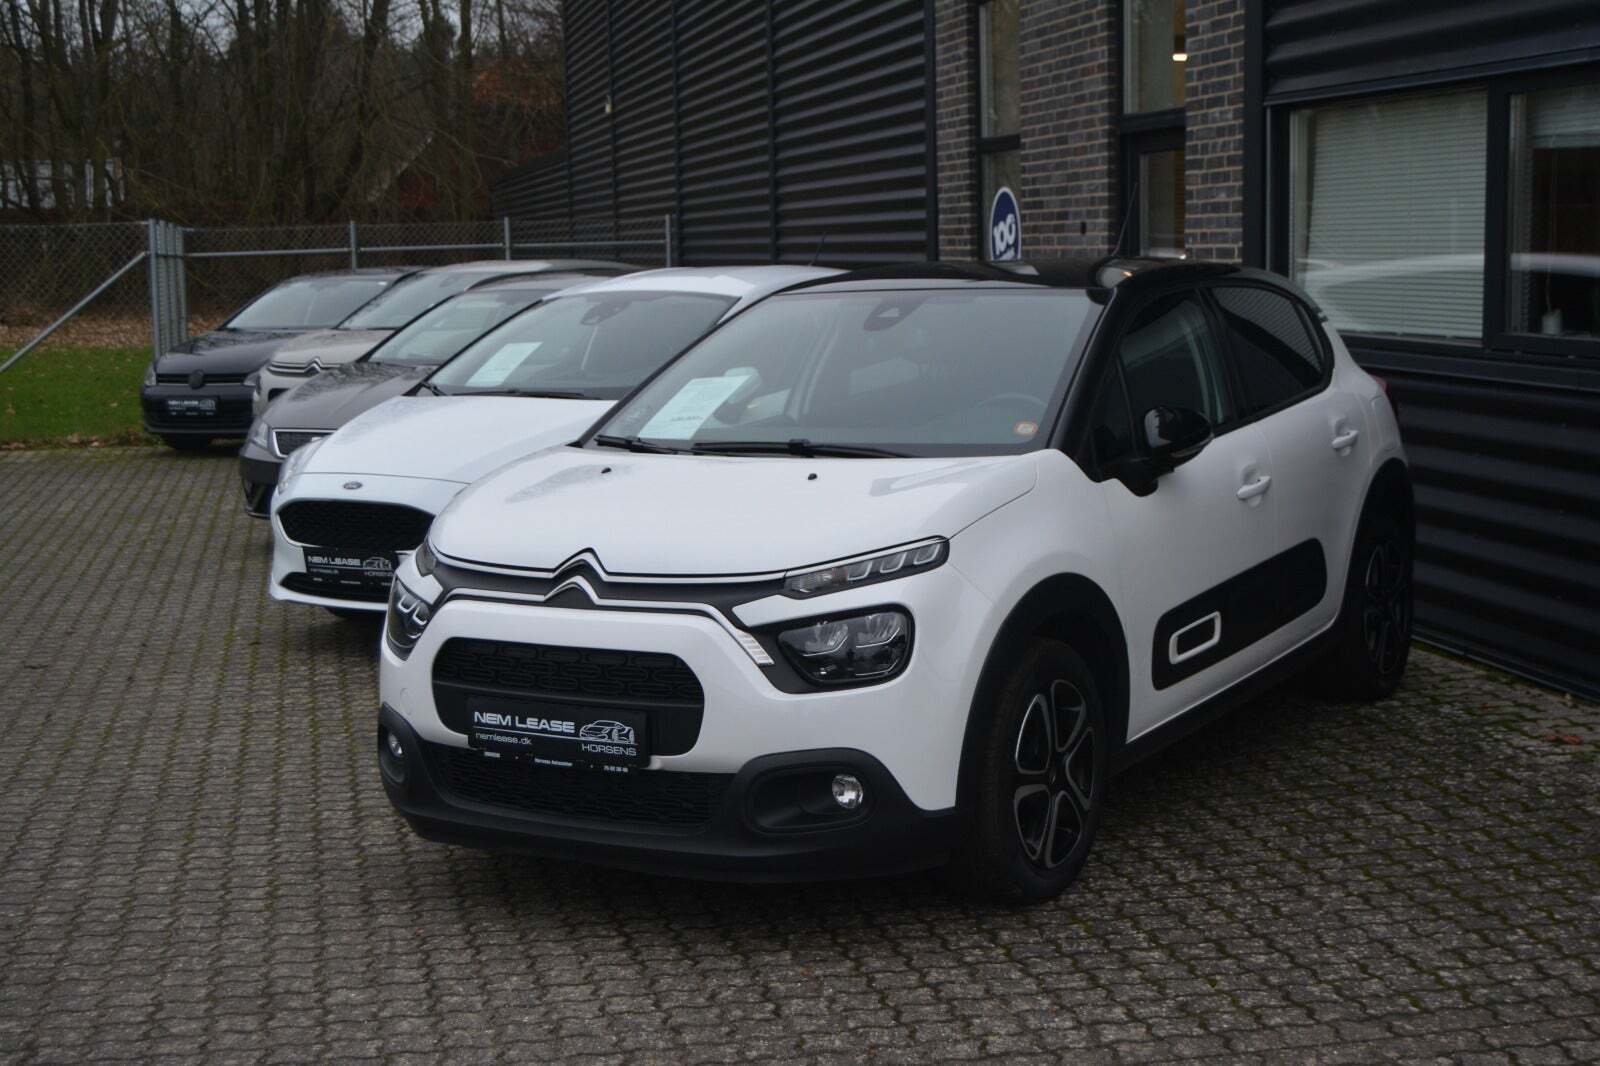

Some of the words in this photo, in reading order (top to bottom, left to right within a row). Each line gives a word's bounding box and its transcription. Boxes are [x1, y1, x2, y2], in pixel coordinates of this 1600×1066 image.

[308, 556, 328, 565] NEM
[329, 557, 361, 566] LEASE
[474, 711, 512, 726] NEM
[515, 715, 576, 734] LEASE
[475, 732, 532, 746] nemlease.dk
[581, 743, 637, 757] HORSENS
